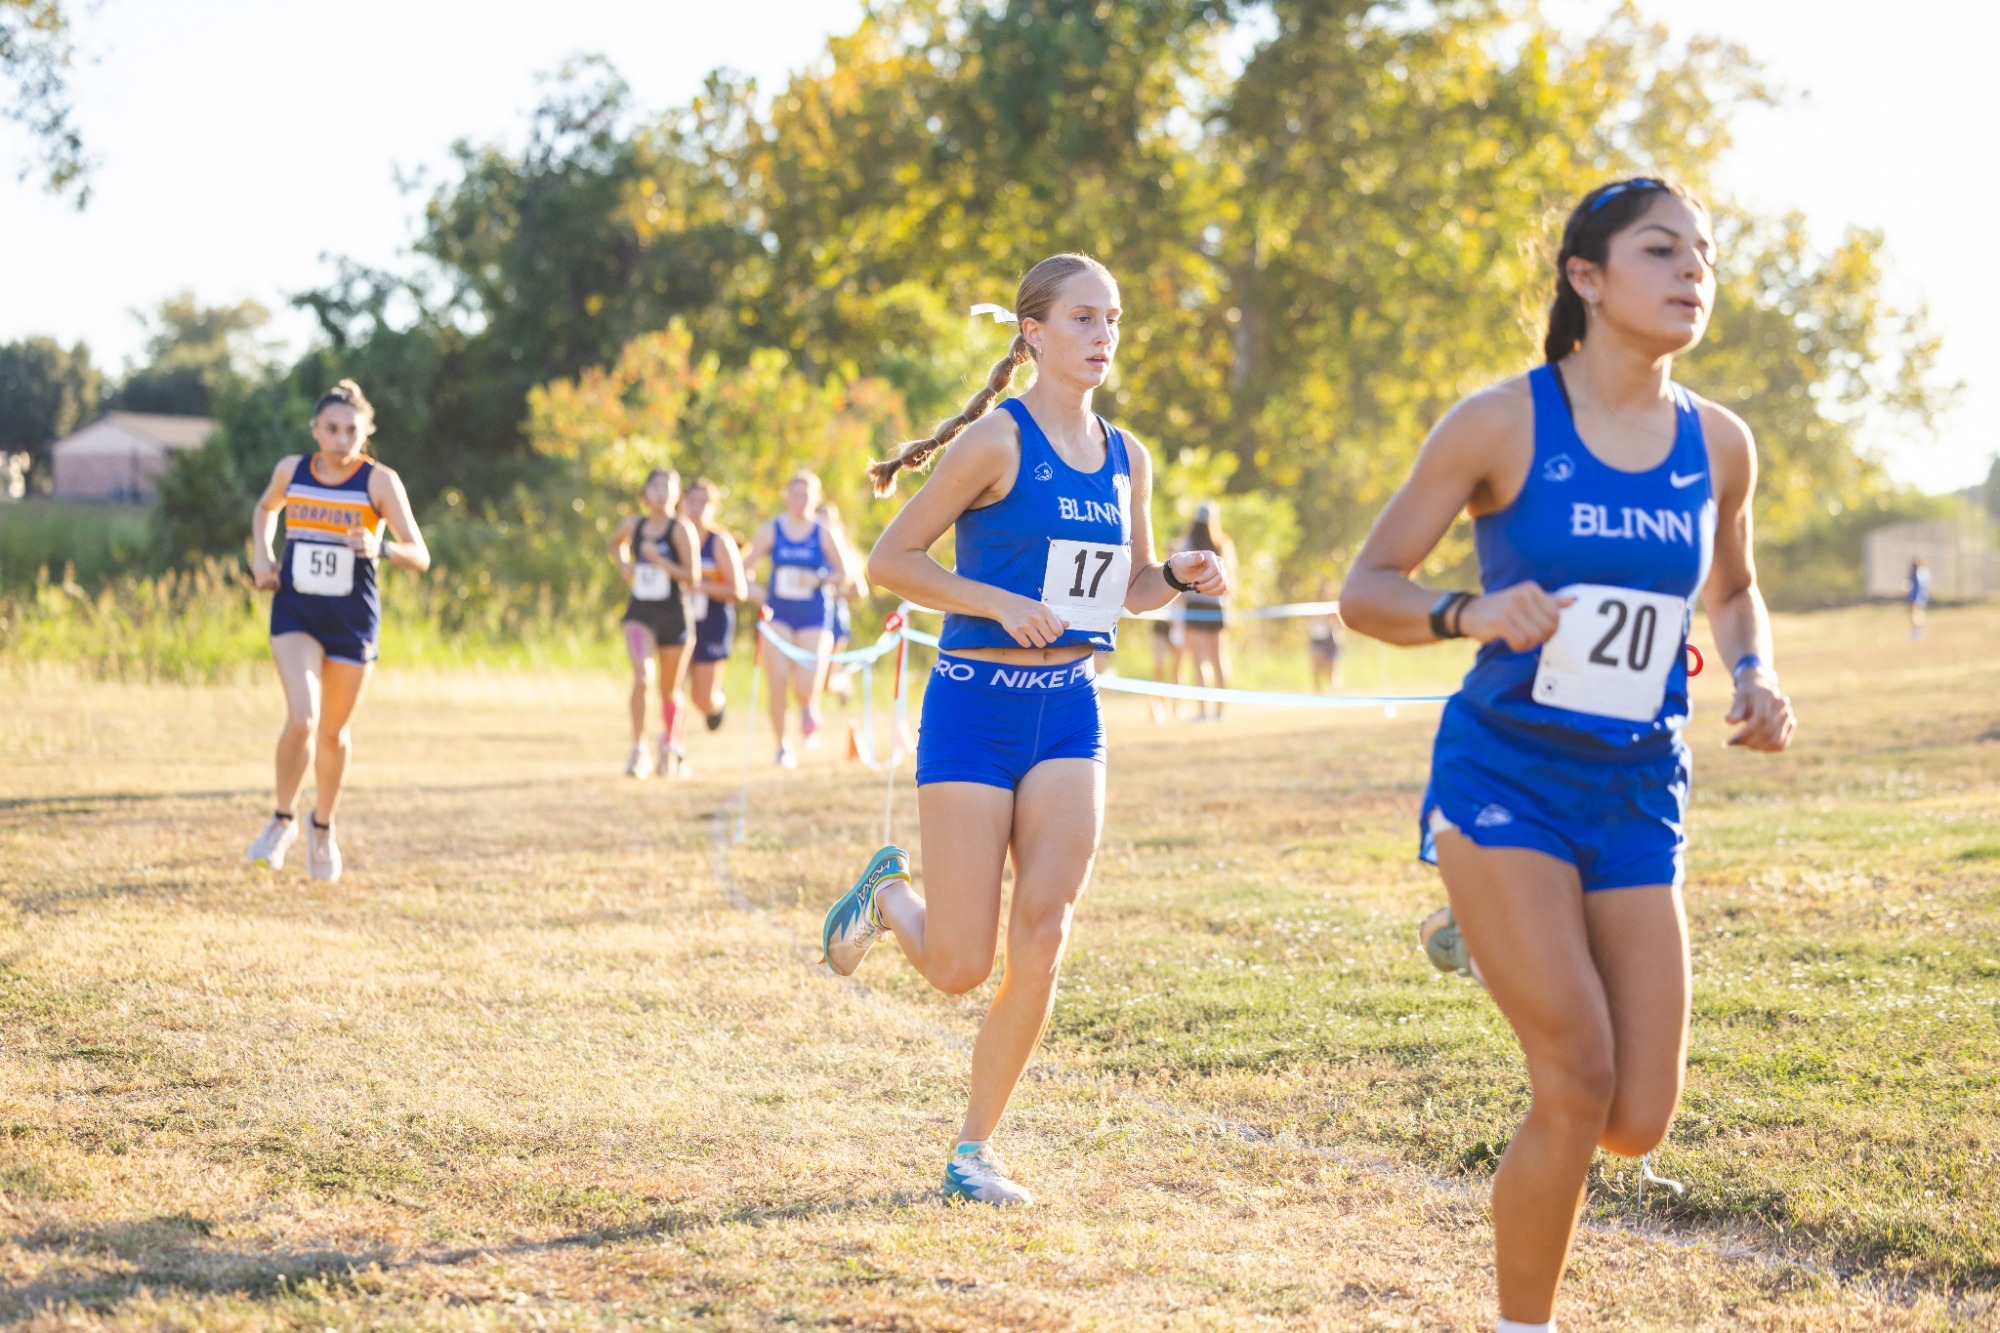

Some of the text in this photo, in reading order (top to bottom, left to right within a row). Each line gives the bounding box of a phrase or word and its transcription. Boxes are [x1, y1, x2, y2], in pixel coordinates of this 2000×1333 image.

[1057, 496, 1122, 526] BLINN
[1569, 501, 1693, 547] BLINN
[310, 551, 336, 576] 59
[1069, 549, 1113, 598] 17
[1589, 599, 1656, 671] 20
[990, 668, 1068, 688] NIKE
[858, 860, 890, 901] HOKA
